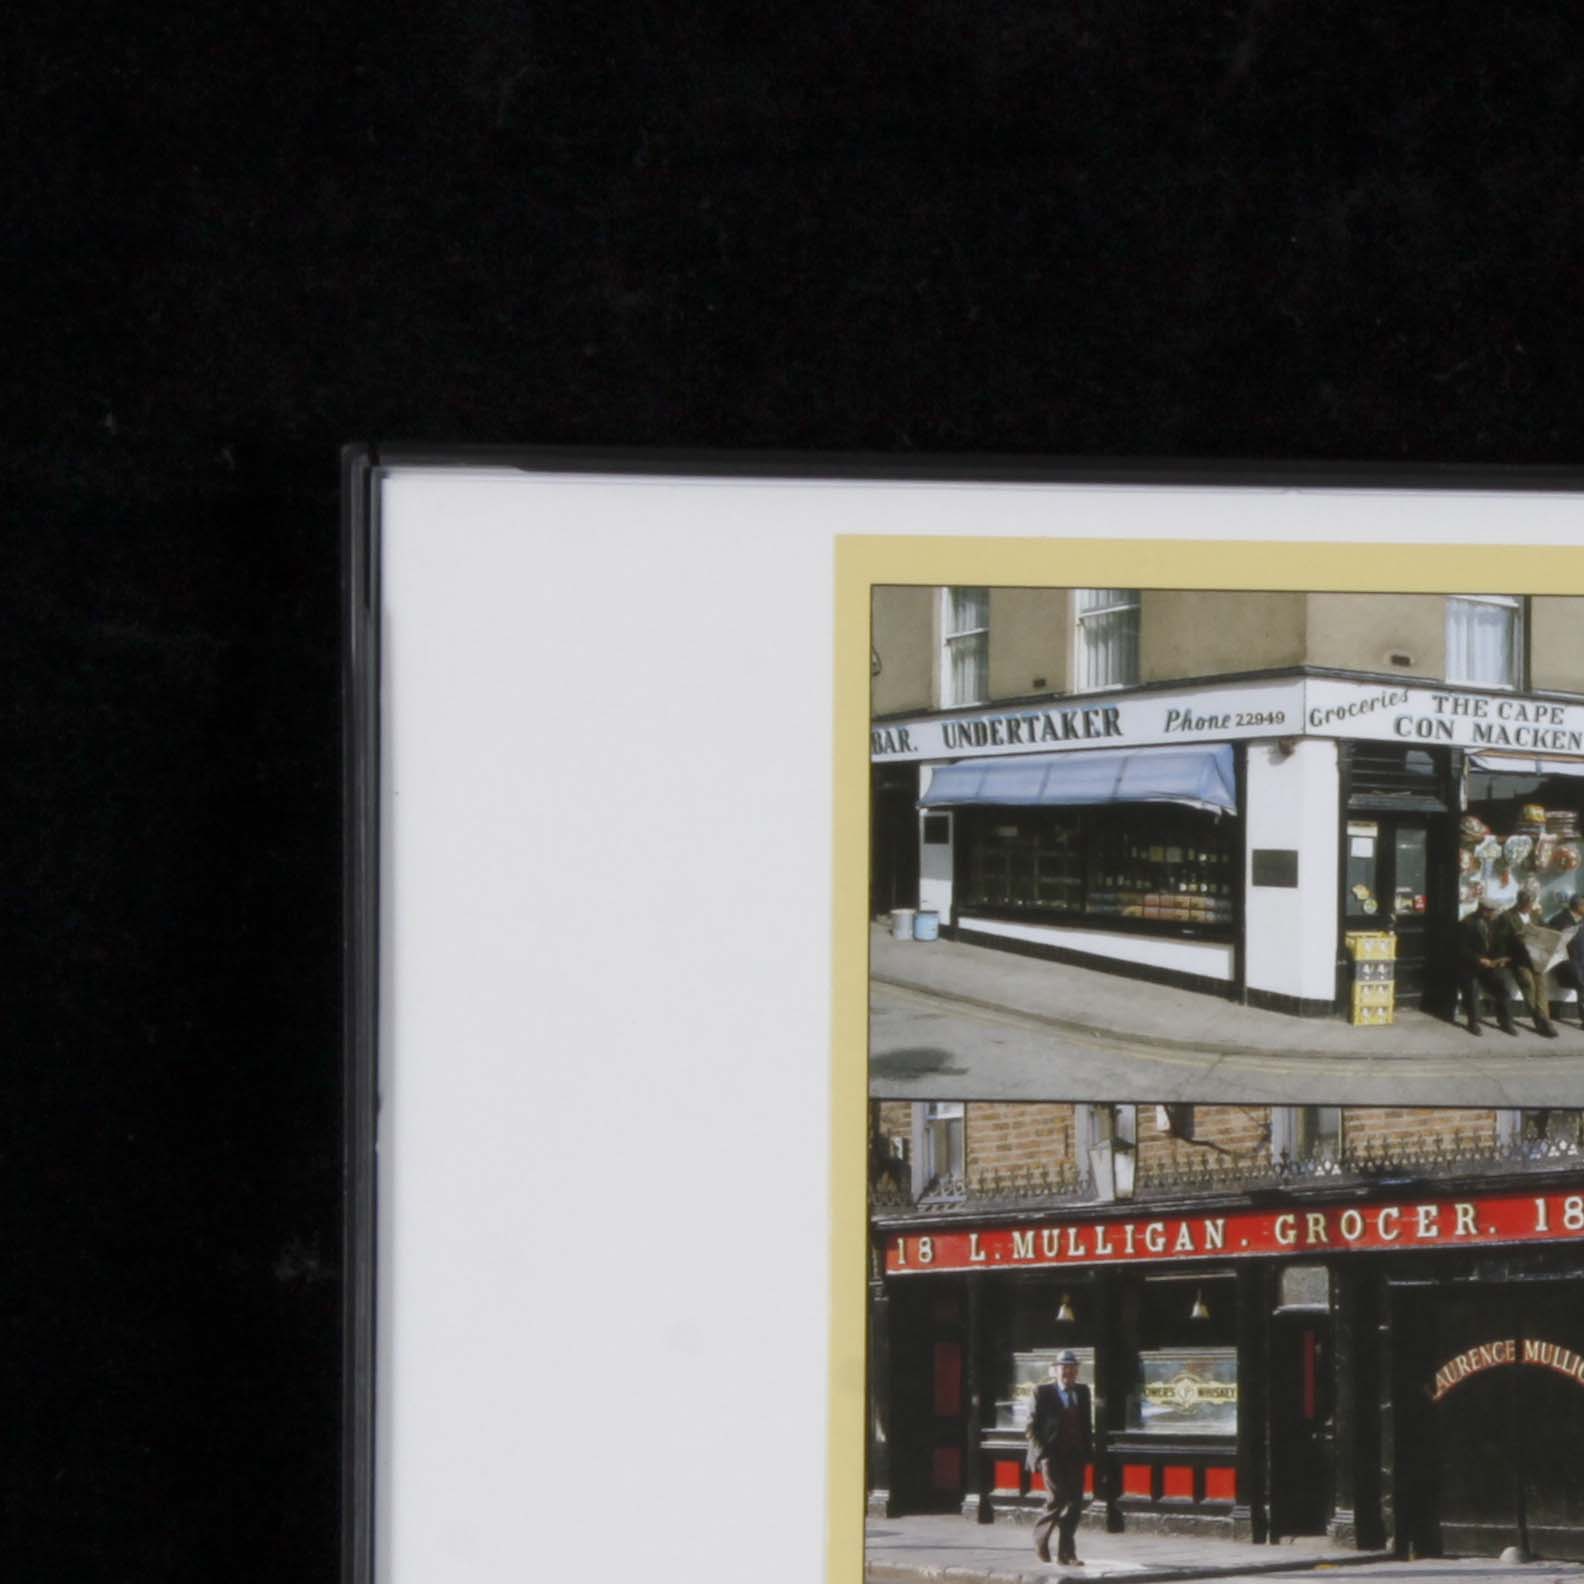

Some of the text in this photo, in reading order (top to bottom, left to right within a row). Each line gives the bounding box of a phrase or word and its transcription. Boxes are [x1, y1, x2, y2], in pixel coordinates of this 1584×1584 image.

[1432, 695, 1565, 725] THE CAPE
[942, 708, 1123, 748] UNDERTAKER
[1163, 709, 1232, 733] Phone
[1236, 712, 1285, 727] 22949
[1394, 716, 1584, 750] CON MACKEN
[896, 1237, 934, 1264] 18
